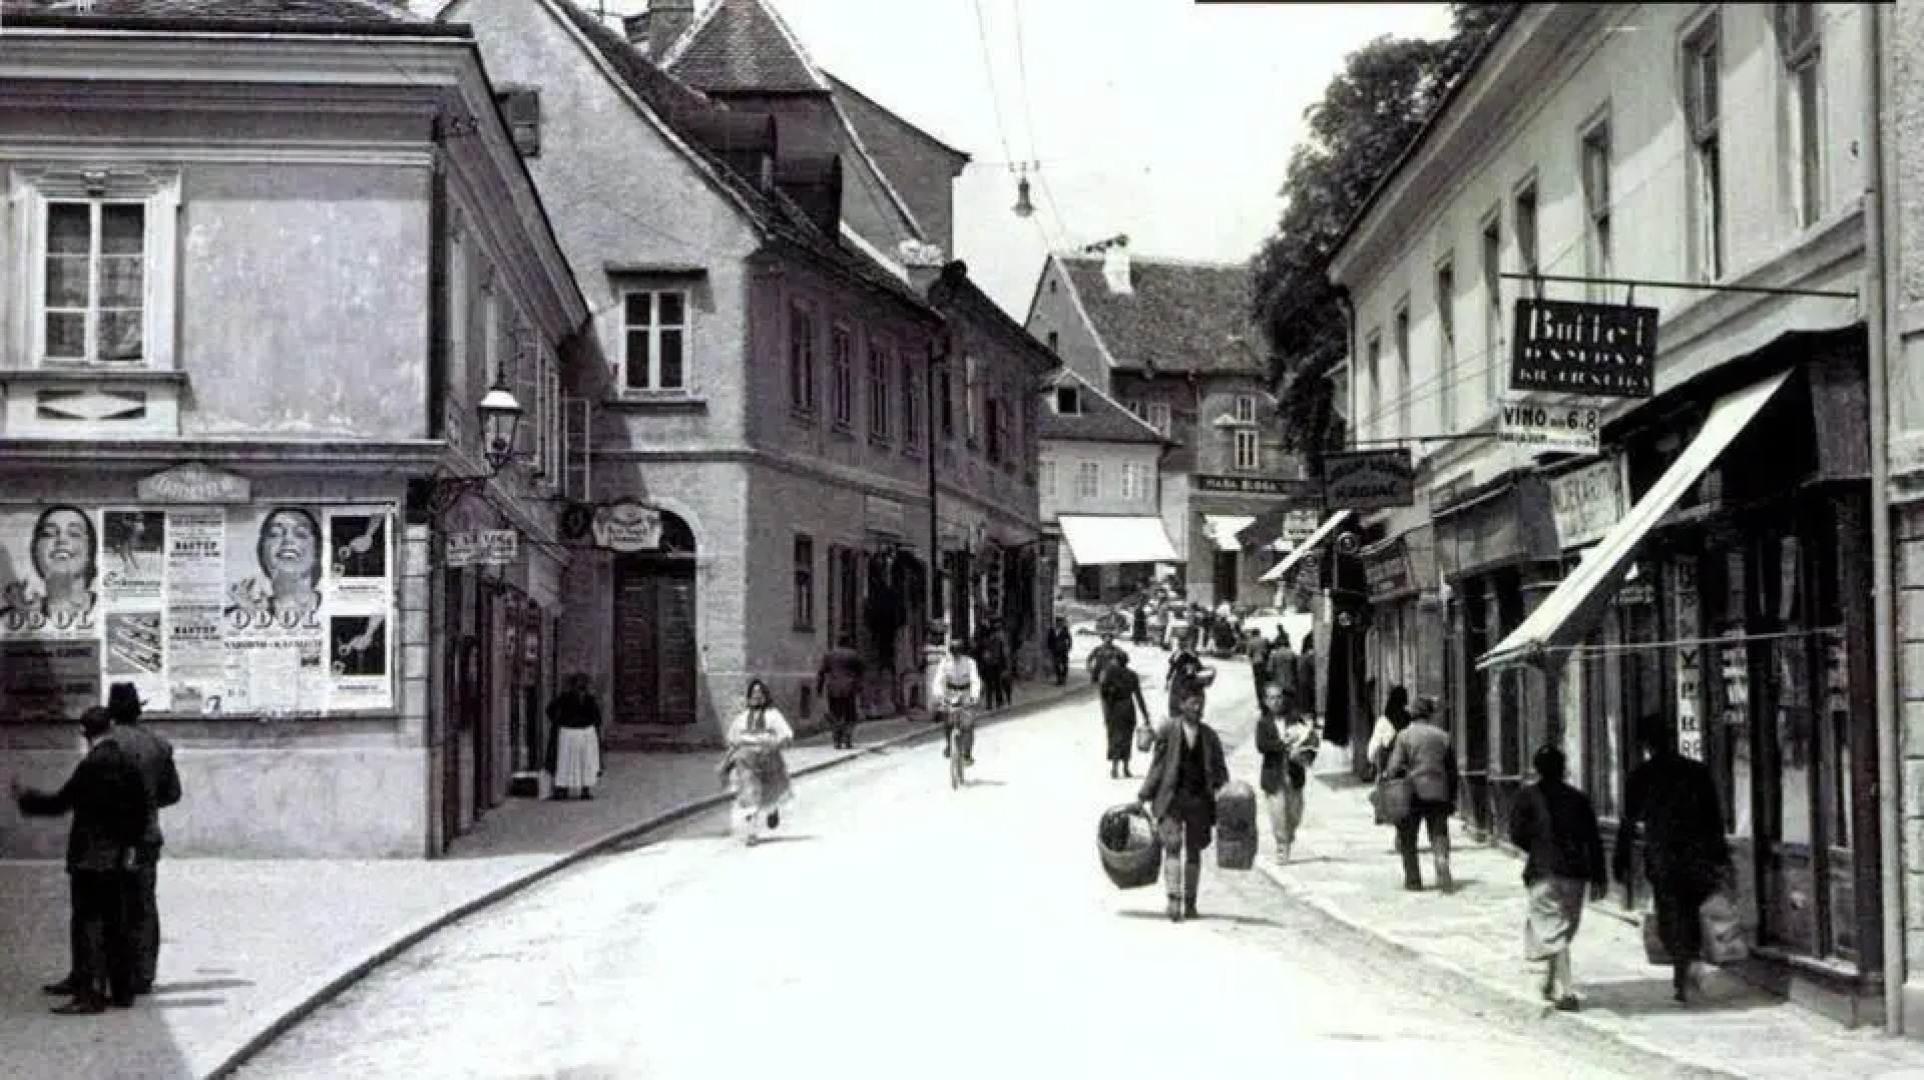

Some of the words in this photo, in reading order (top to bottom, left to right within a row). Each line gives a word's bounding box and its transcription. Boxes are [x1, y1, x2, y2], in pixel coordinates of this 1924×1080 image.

[1504, 407, 1546, 426] VINO
[5, 610, 95, 631] ODOL
[229, 609, 321, 630] ODOL
